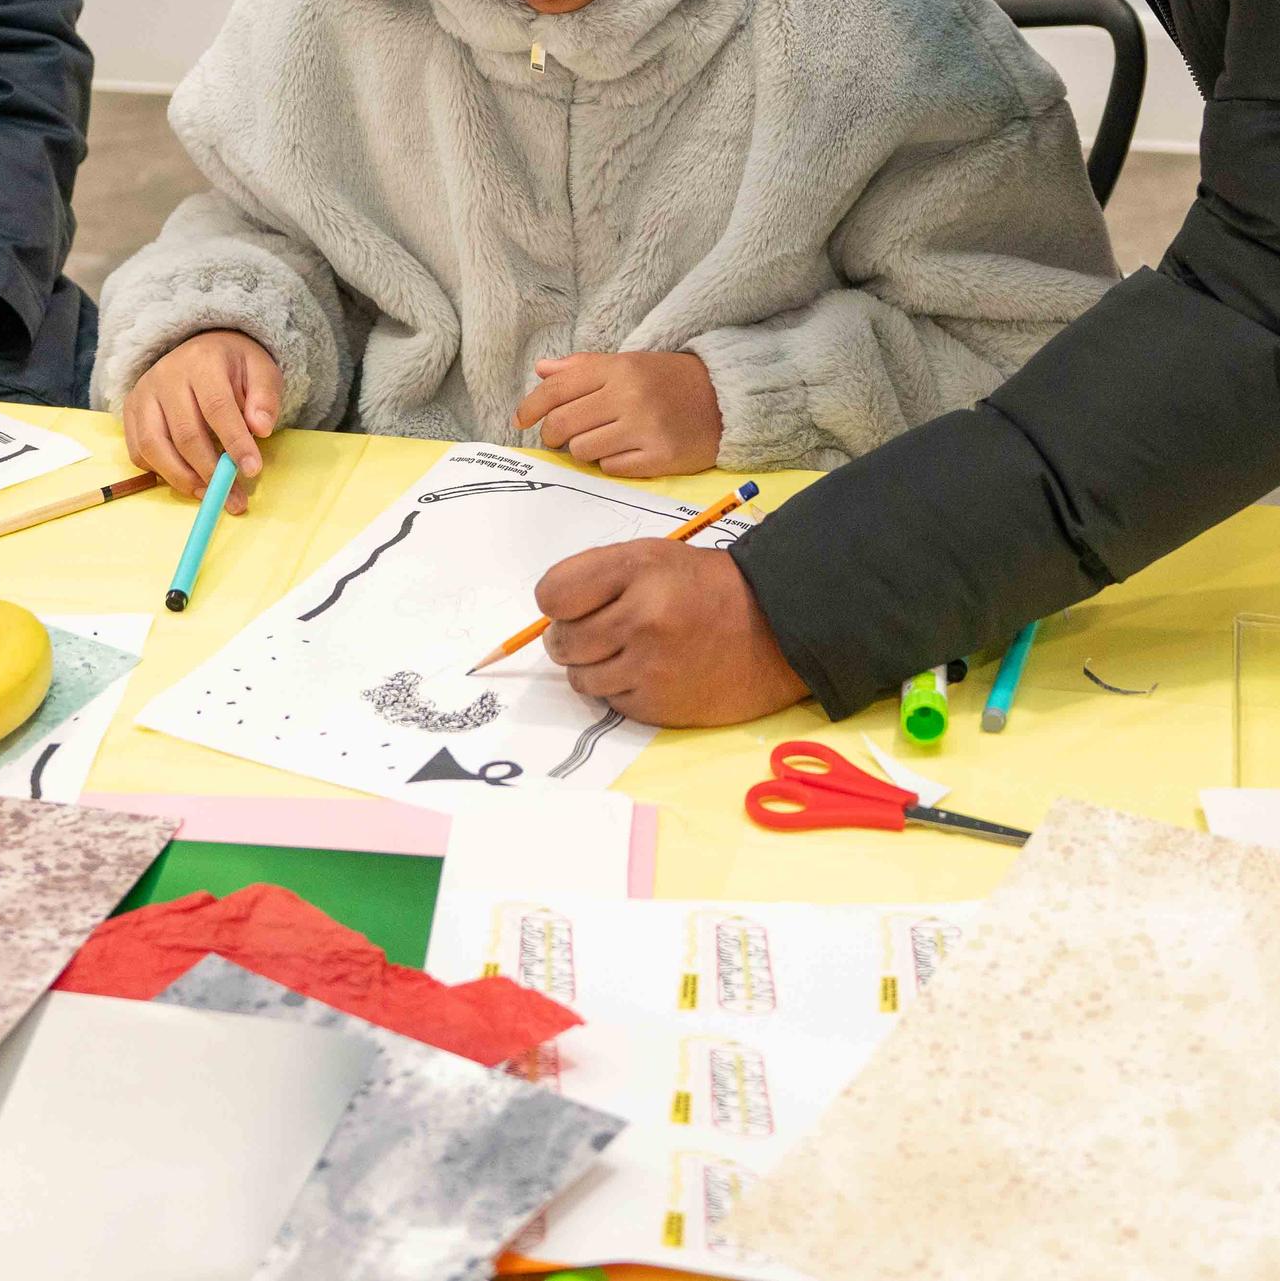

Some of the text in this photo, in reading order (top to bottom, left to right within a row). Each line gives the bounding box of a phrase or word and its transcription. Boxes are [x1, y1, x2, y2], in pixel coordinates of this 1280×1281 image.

[476, 451, 534, 471] for Illustration
[476, 459, 498, 468] Blake
[497, 463, 528, 477] Quentin
